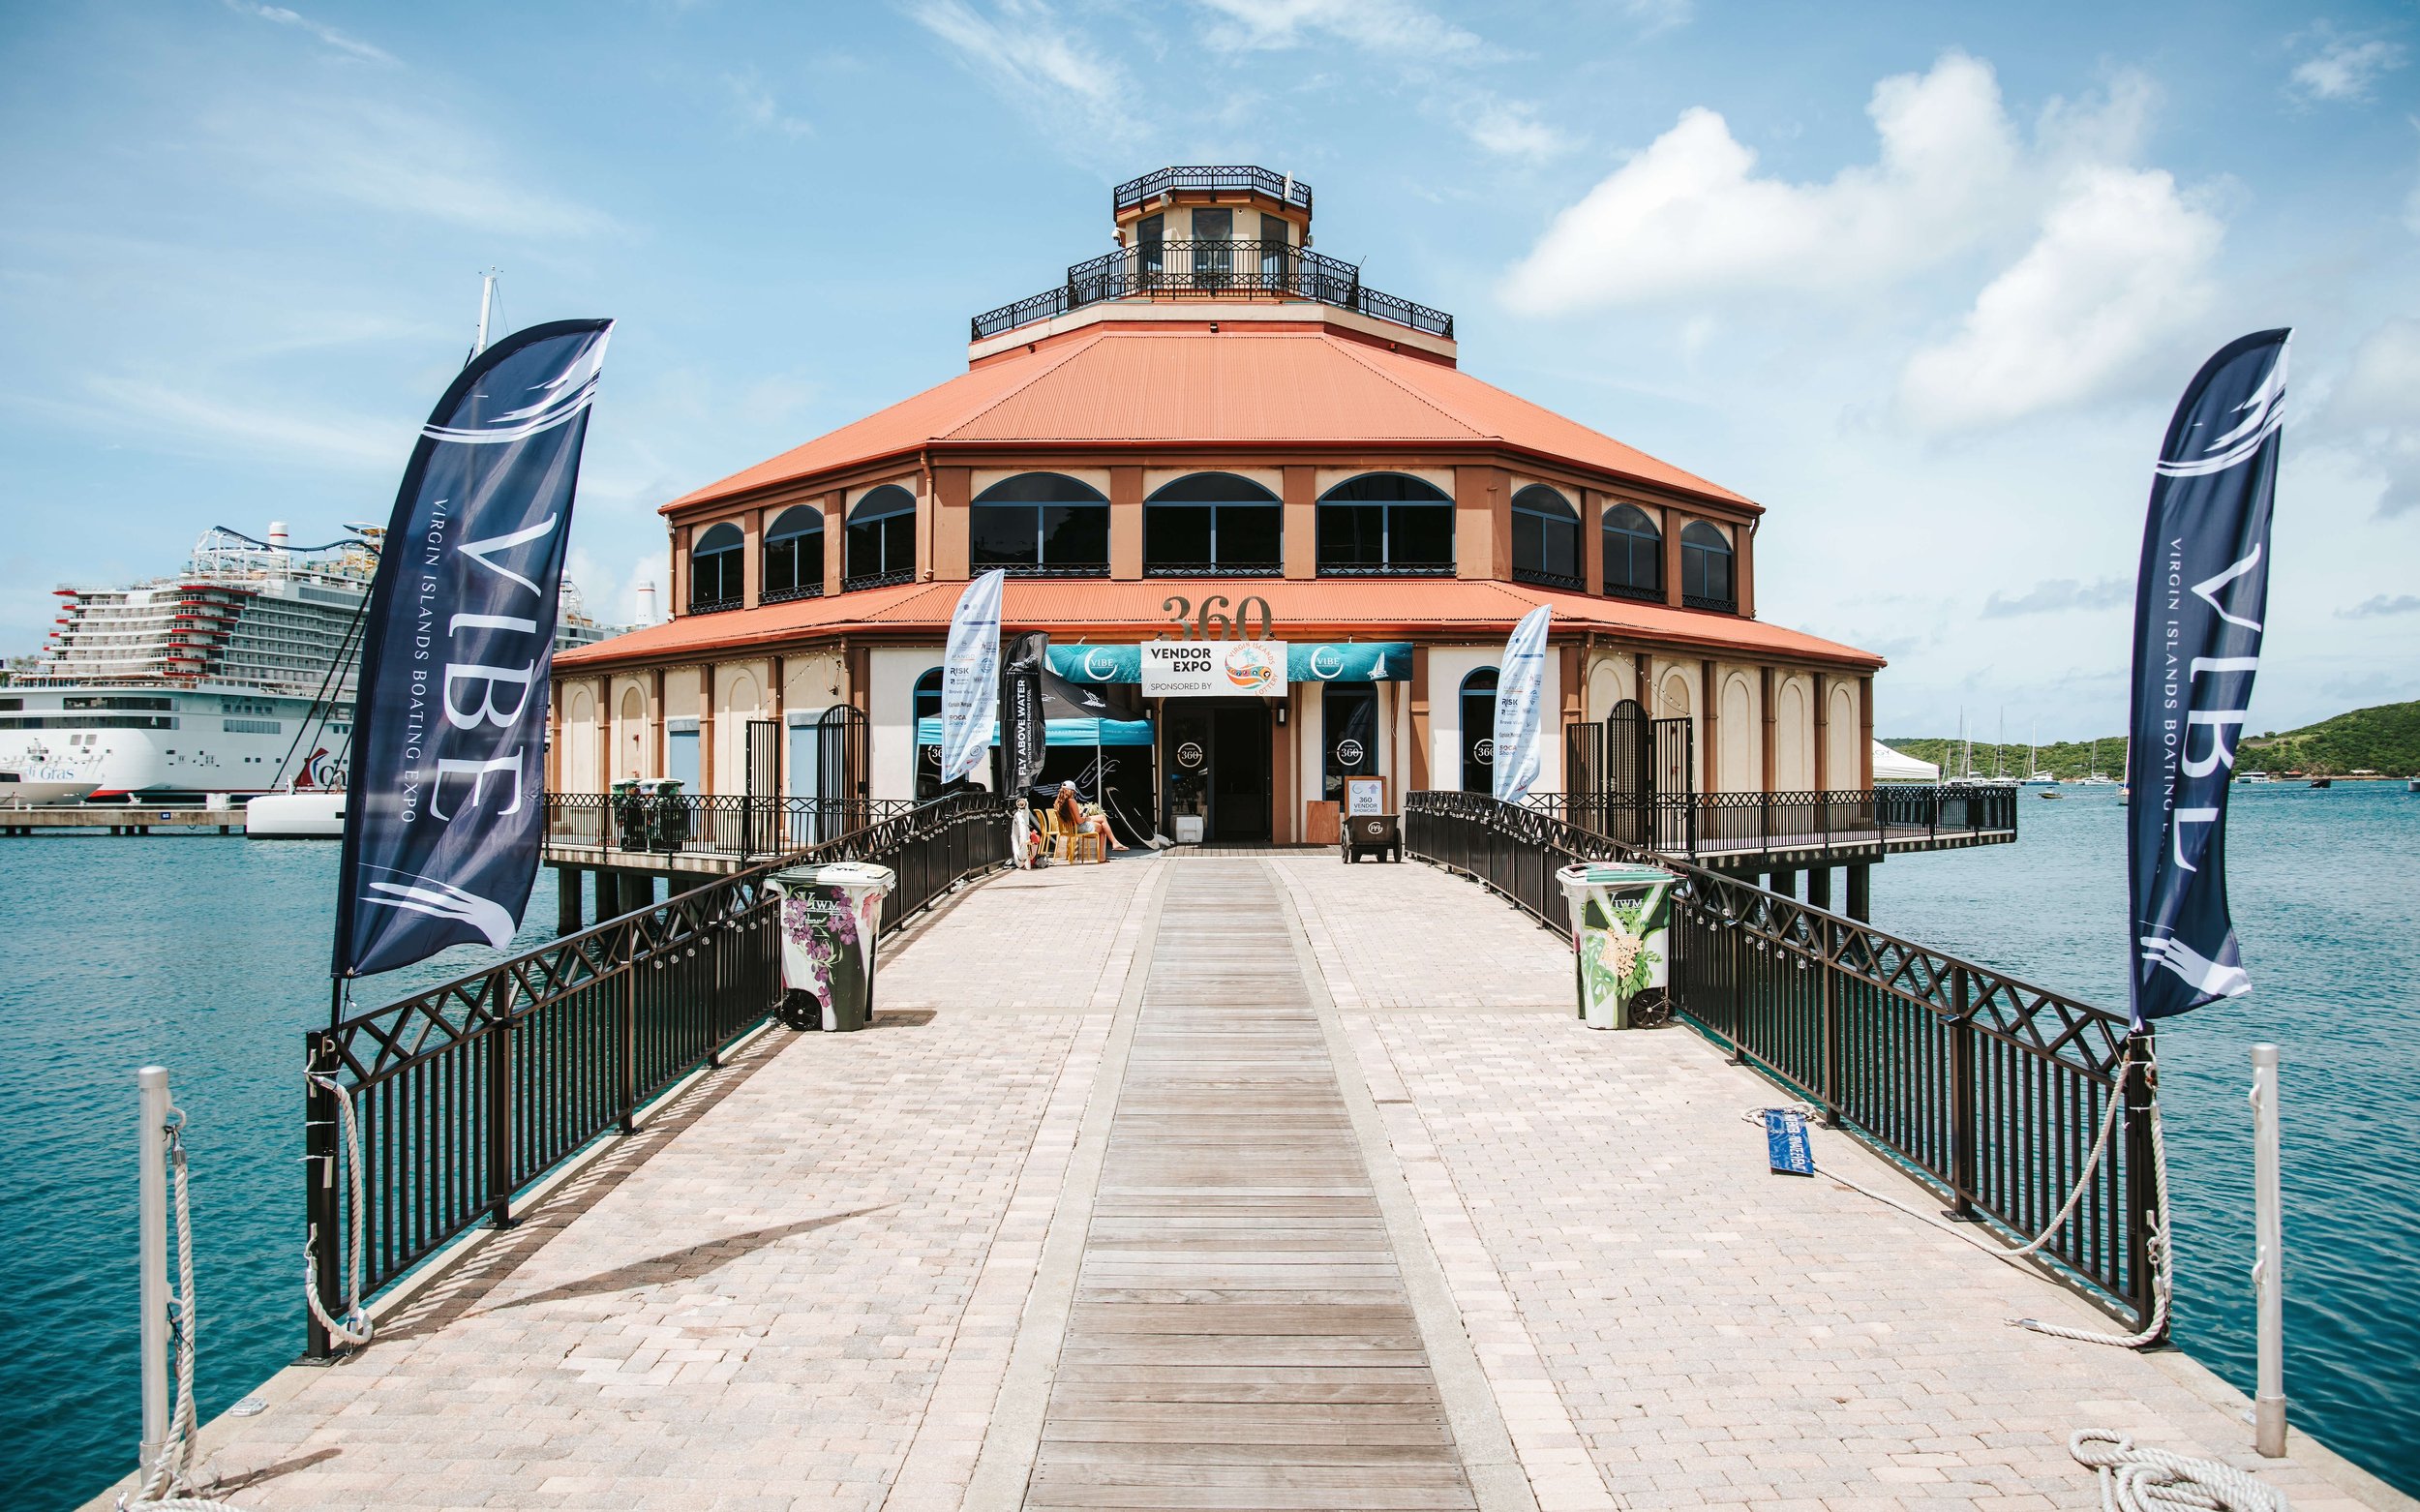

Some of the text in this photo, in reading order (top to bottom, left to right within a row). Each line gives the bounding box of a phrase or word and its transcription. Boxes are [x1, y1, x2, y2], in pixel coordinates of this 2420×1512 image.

[1163, 595, 1272, 641] 360
[1151, 648, 1212, 659] VENDOR
[1229, 642, 1275, 665] VIRGIN ISLANDS
[401, 499, 448, 823] VIRGIN ISLANDS BOATING EXPO
[430, 512, 558, 822] VIBE
[1091, 658, 1114, 667] VIBE
[1173, 661, 1212, 672] EXPO
[2163, 537, 2182, 811] VIRGIN ISLANDS BOATING
[1151, 682, 1200, 691] SPONSORED
[1255, 674, 1278, 696] LOTTERY
[1501, 698, 1519, 707] RISK
[1017, 680, 1027, 776] FLY ABOVE WATER
[931, 749, 943, 758] 36
[1181, 750, 1199, 760] 360
[1341, 747, 1360, 758] 360
[41, 766, 74, 780] Gras
